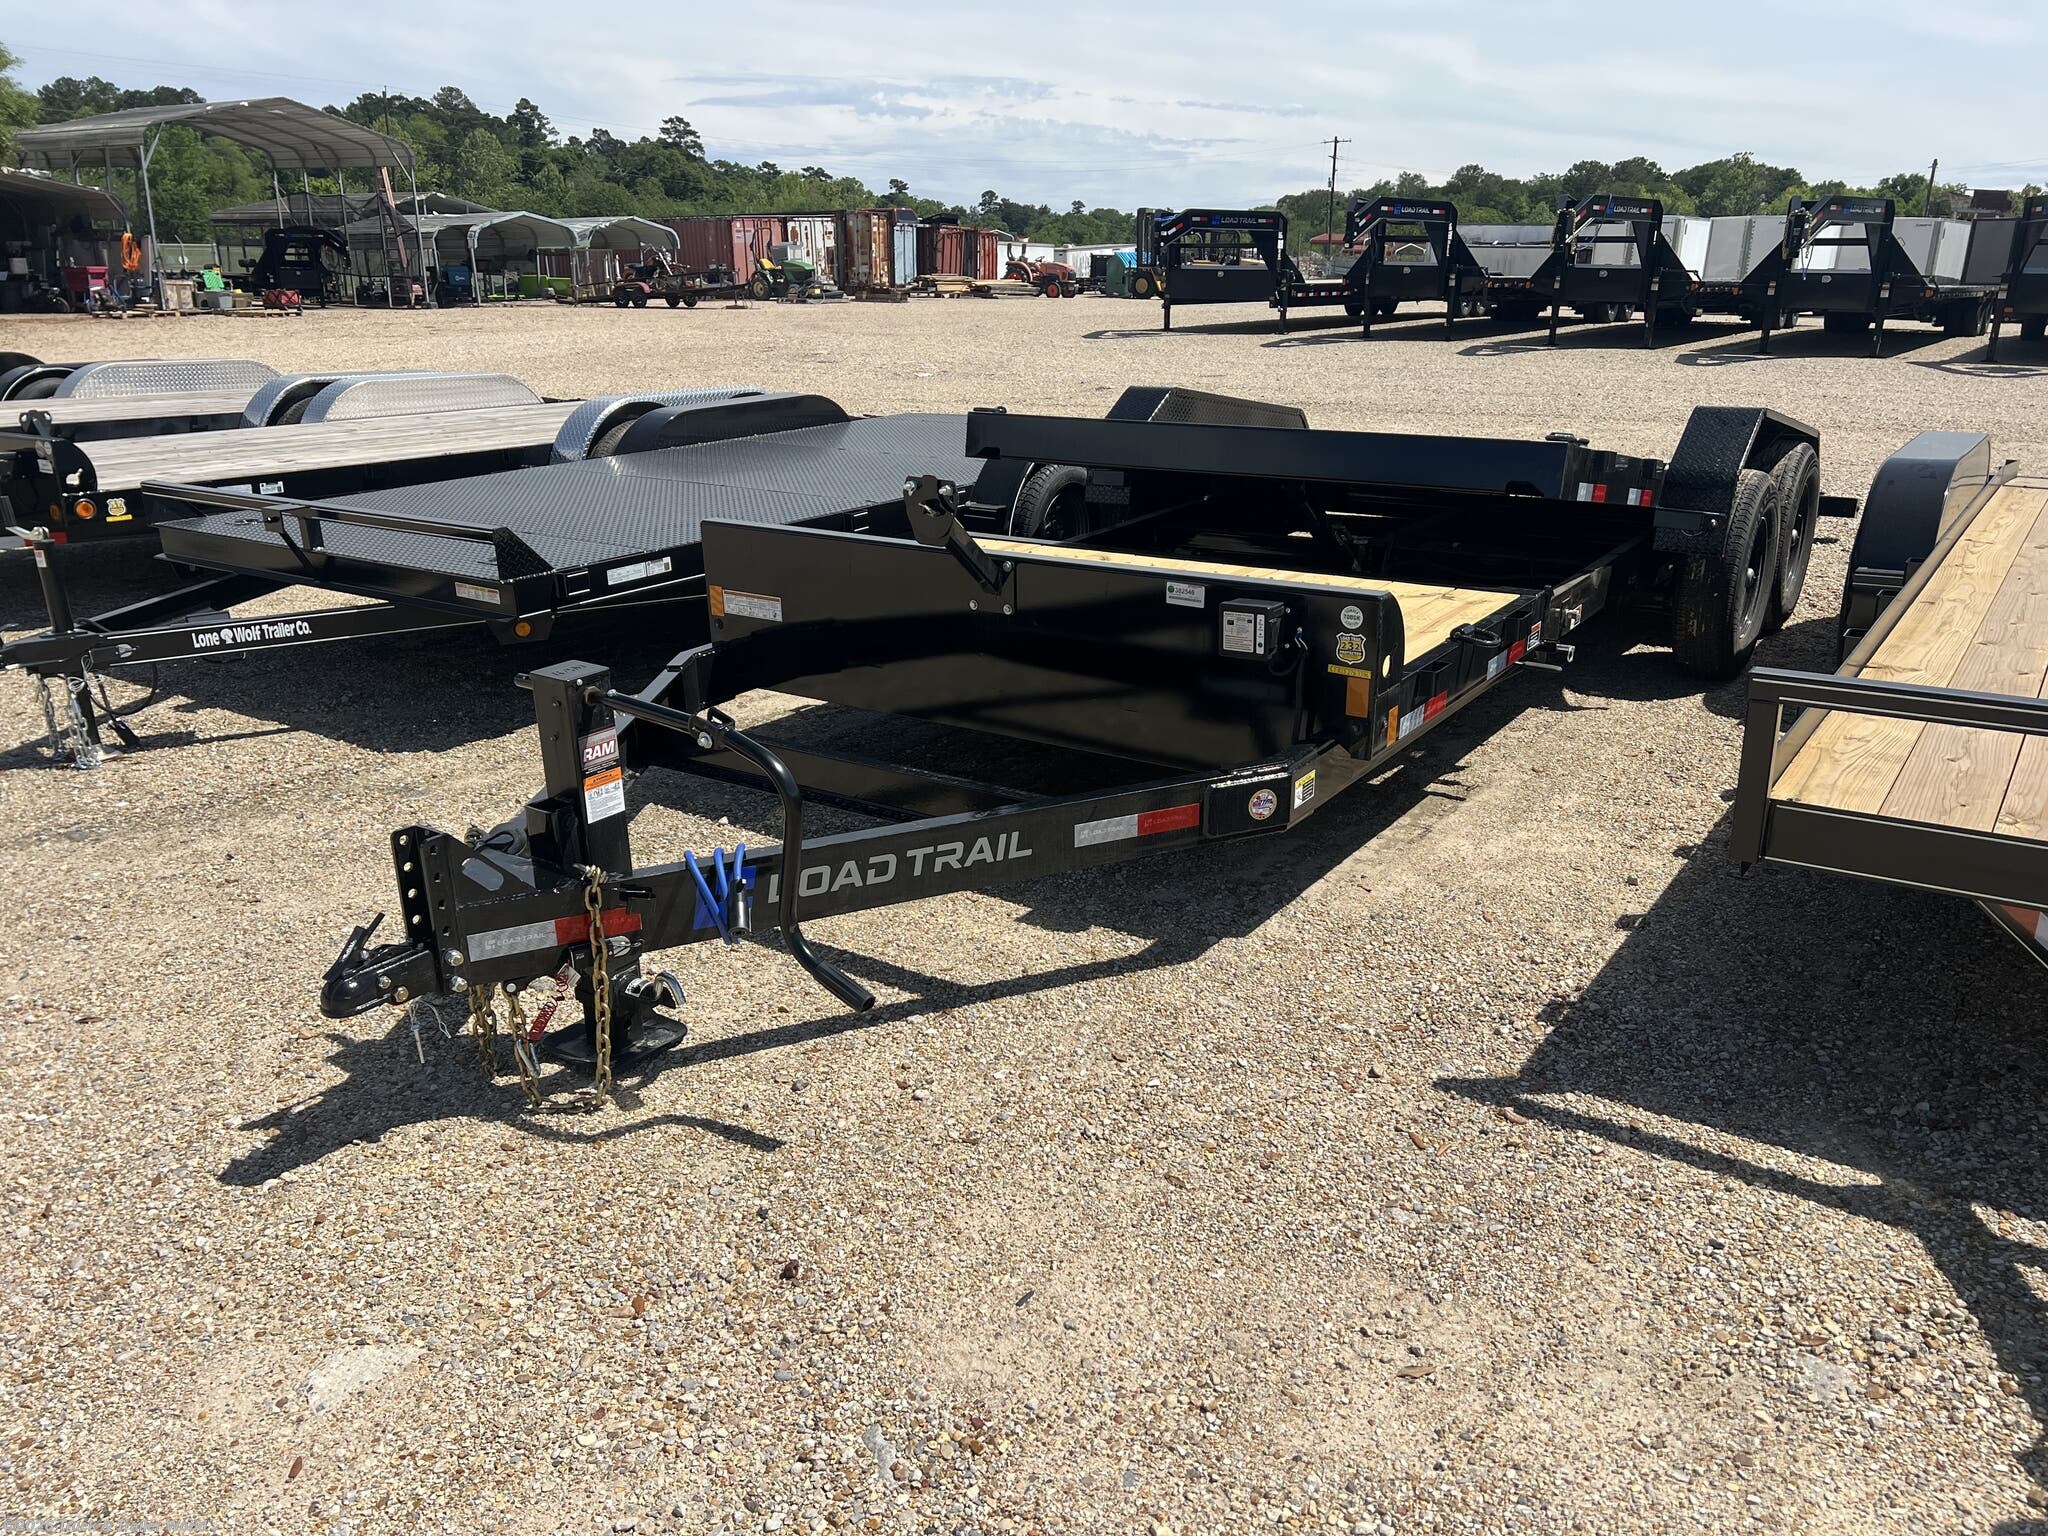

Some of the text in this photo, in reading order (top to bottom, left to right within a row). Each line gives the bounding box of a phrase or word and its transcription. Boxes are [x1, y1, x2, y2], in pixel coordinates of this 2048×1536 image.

[1221, 216, 1239, 224] LOAD
[192, 620, 312, 648] Lone Wolf Trailer Co.
[1341, 641, 1360, 651] 232
[583, 740, 616, 763] RAM
[906, 831, 1033, 876] TRAIL
